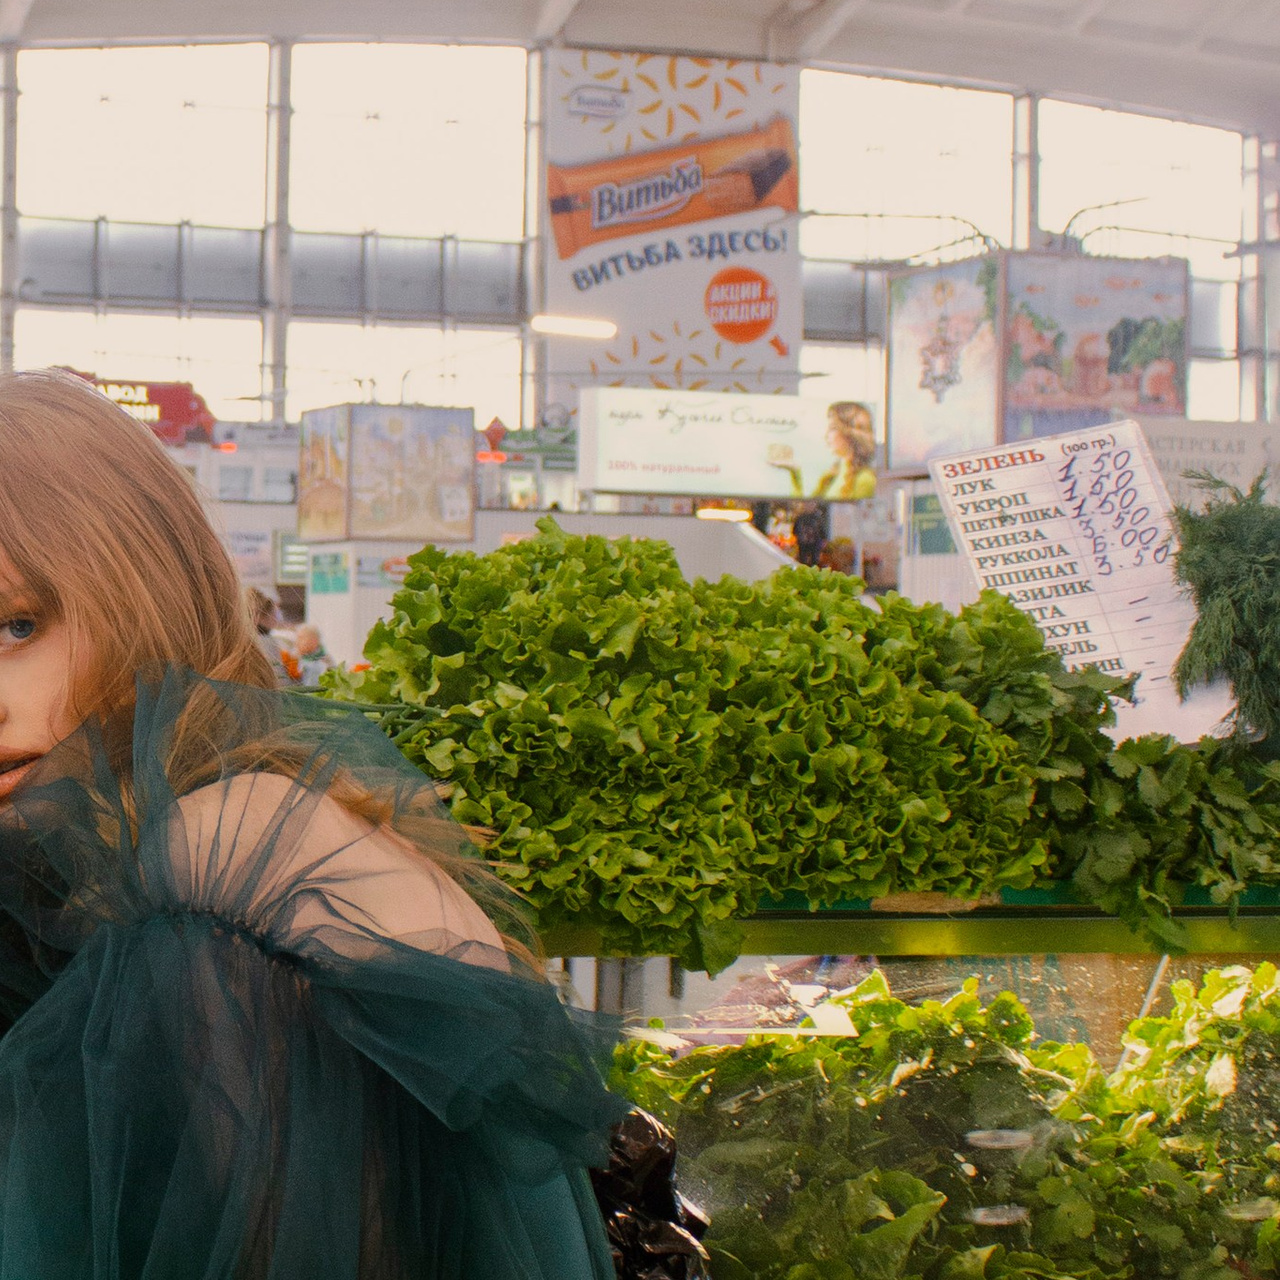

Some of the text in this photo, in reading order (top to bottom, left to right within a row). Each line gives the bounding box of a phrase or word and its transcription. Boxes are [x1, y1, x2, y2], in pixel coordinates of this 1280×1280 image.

[596, 166, 702, 221] Витьба
[571, 228, 789, 291] ВИТЬБА ЗДЕСЬ!
[942, 448, 1046, 479] ЗЕЛЕНЬ
[951, 478, 997, 497] ЛУК
[956, 492, 1031, 516] УКРОП
[961, 506, 1067, 534] ПЕТРУШКА
[969, 528, 1049, 552] КИНЗА
[975, 543, 1071, 571] РУККОЛА
[981, 560, 1080, 589] ШПИНАТ
[1005, 579, 1096, 605] АЗИЛИК
[1046, 620, 1092, 640] ХУН
